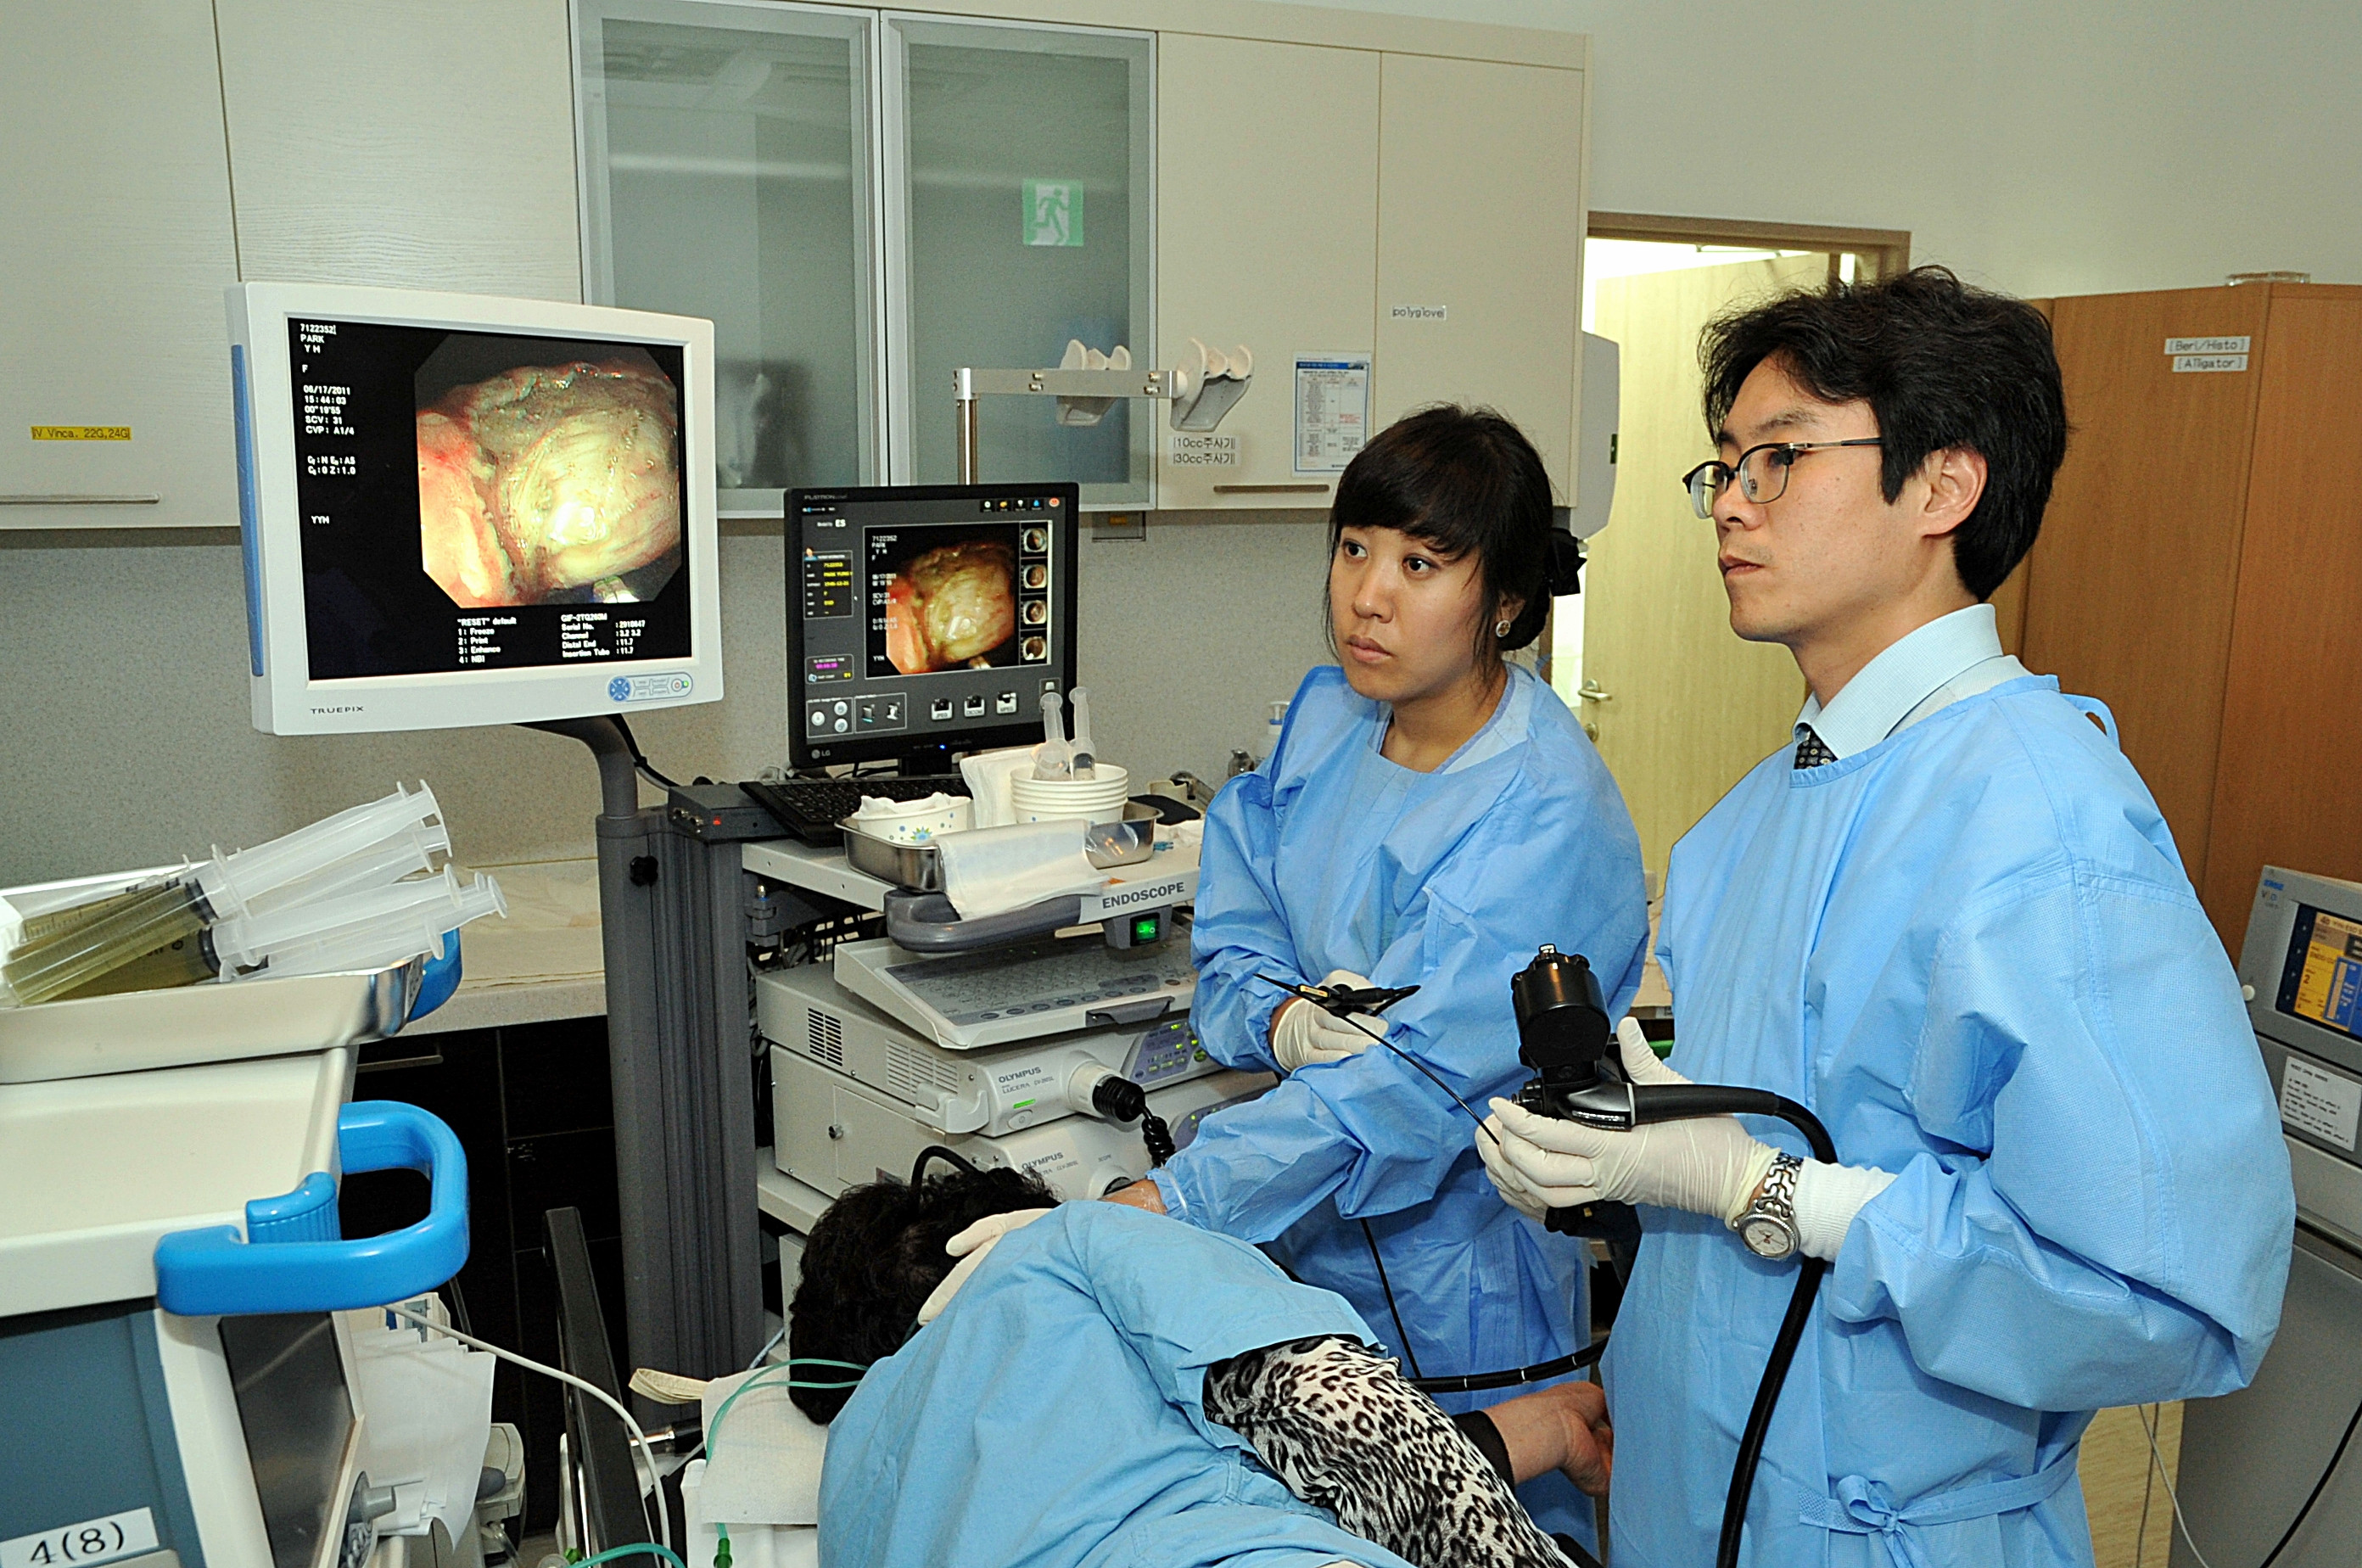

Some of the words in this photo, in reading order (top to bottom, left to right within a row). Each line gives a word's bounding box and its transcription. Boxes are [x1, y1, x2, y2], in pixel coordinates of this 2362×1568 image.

[300, 333, 324, 343] PARK
[305, 344, 311, 353] Y
[302, 364, 308, 372] F
[333, 416, 342, 424] 31
[470, 636, 489, 645] Print
[311, 706, 363, 714] TRUEPIX
[1103, 882, 1184, 909] ENDOSCOPE
[999, 1067, 1042, 1083] OLYMPUS
[1003, 1082, 1031, 1095] LUCERA
[1021, 1152, 1064, 1170] OLYMPUS
[31, 1521, 124, 1564] 4(8)
